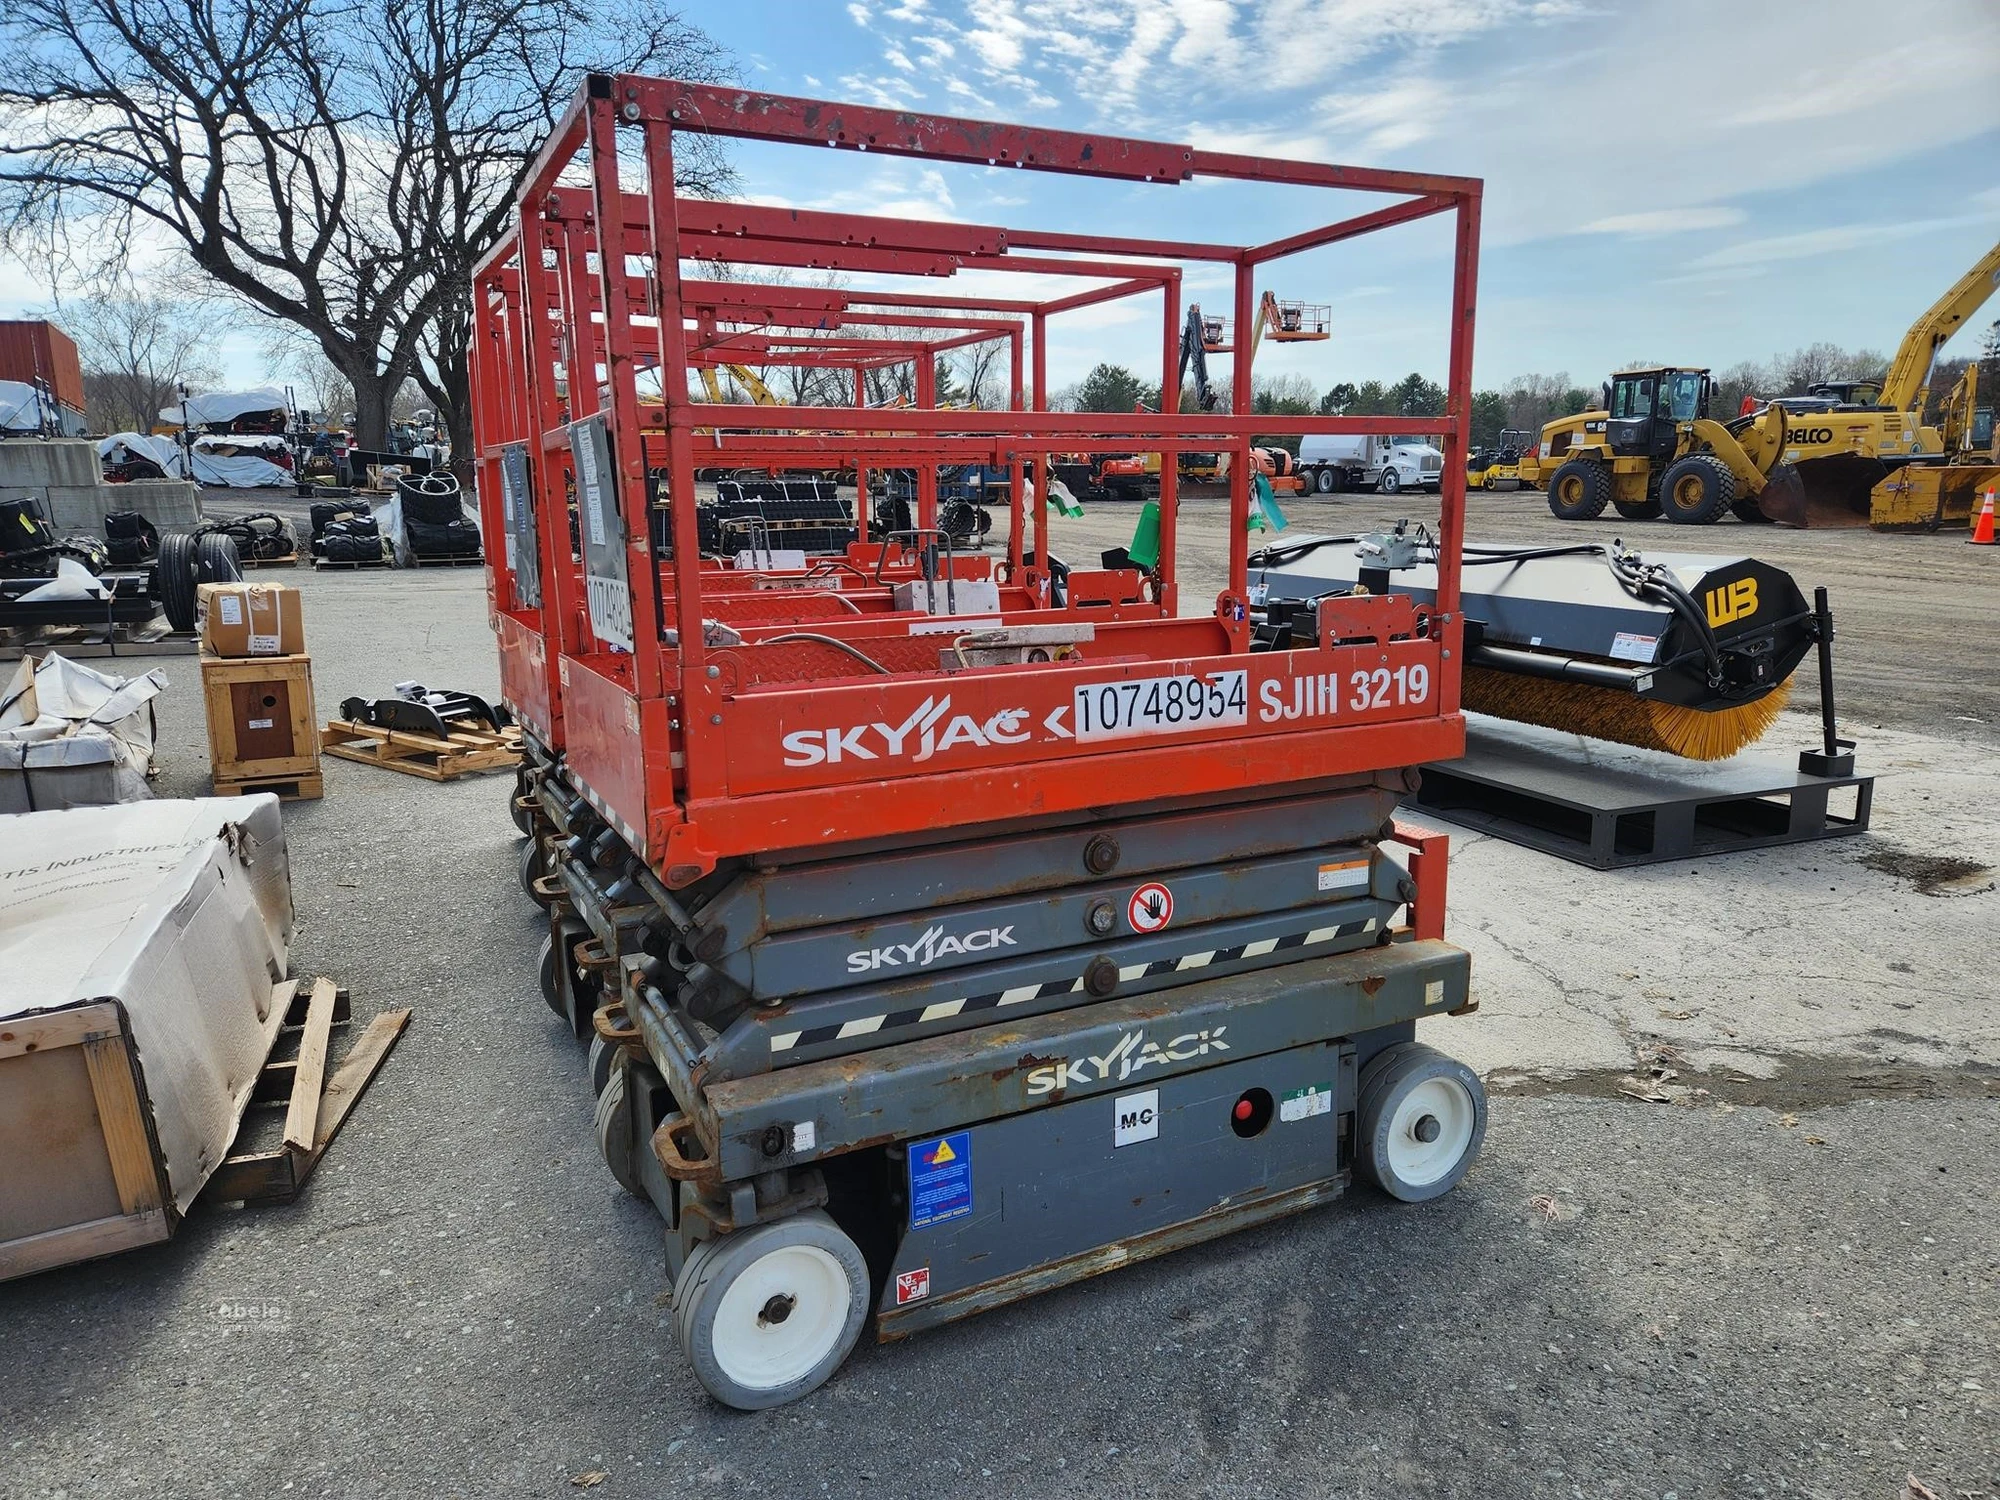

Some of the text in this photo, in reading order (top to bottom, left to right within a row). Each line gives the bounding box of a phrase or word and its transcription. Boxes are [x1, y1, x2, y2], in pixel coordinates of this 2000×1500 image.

[1705, 577, 1759, 629] WB
[1078, 674, 1247, 732] 10748954
[1350, 663, 1429, 712] 3219
[0, 865, 40, 880] TIS
[846, 924, 1018, 973] SKYJACK
[1027, 1025, 1231, 1095] SKYJACK
